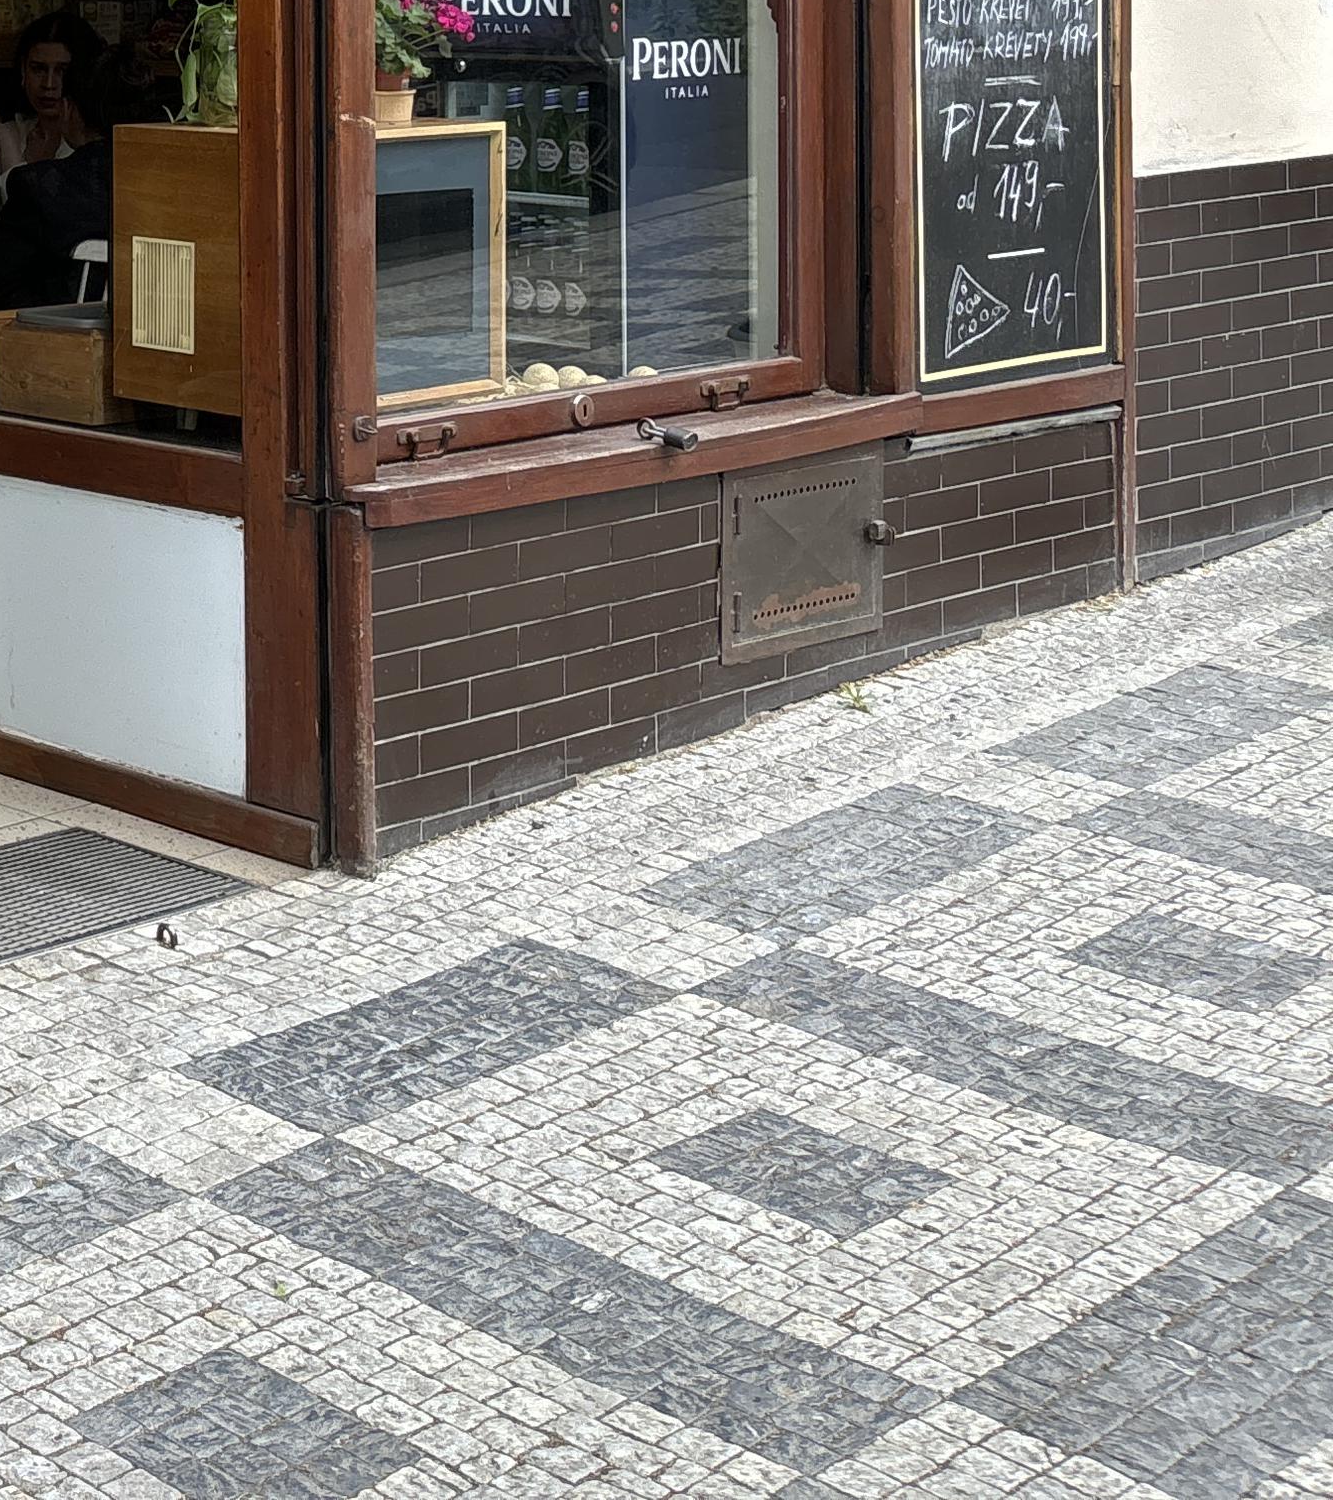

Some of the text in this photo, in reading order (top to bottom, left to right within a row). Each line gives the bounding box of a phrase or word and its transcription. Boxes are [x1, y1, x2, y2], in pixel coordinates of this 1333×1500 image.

[476, 22, 531, 35] ITALIA
[632, 37, 741, 81] PERONI
[665, 85, 709, 99] ITALIA
[939, 95, 1070, 162] PIZZA
[957, 160, 1065, 233] od 149,-
